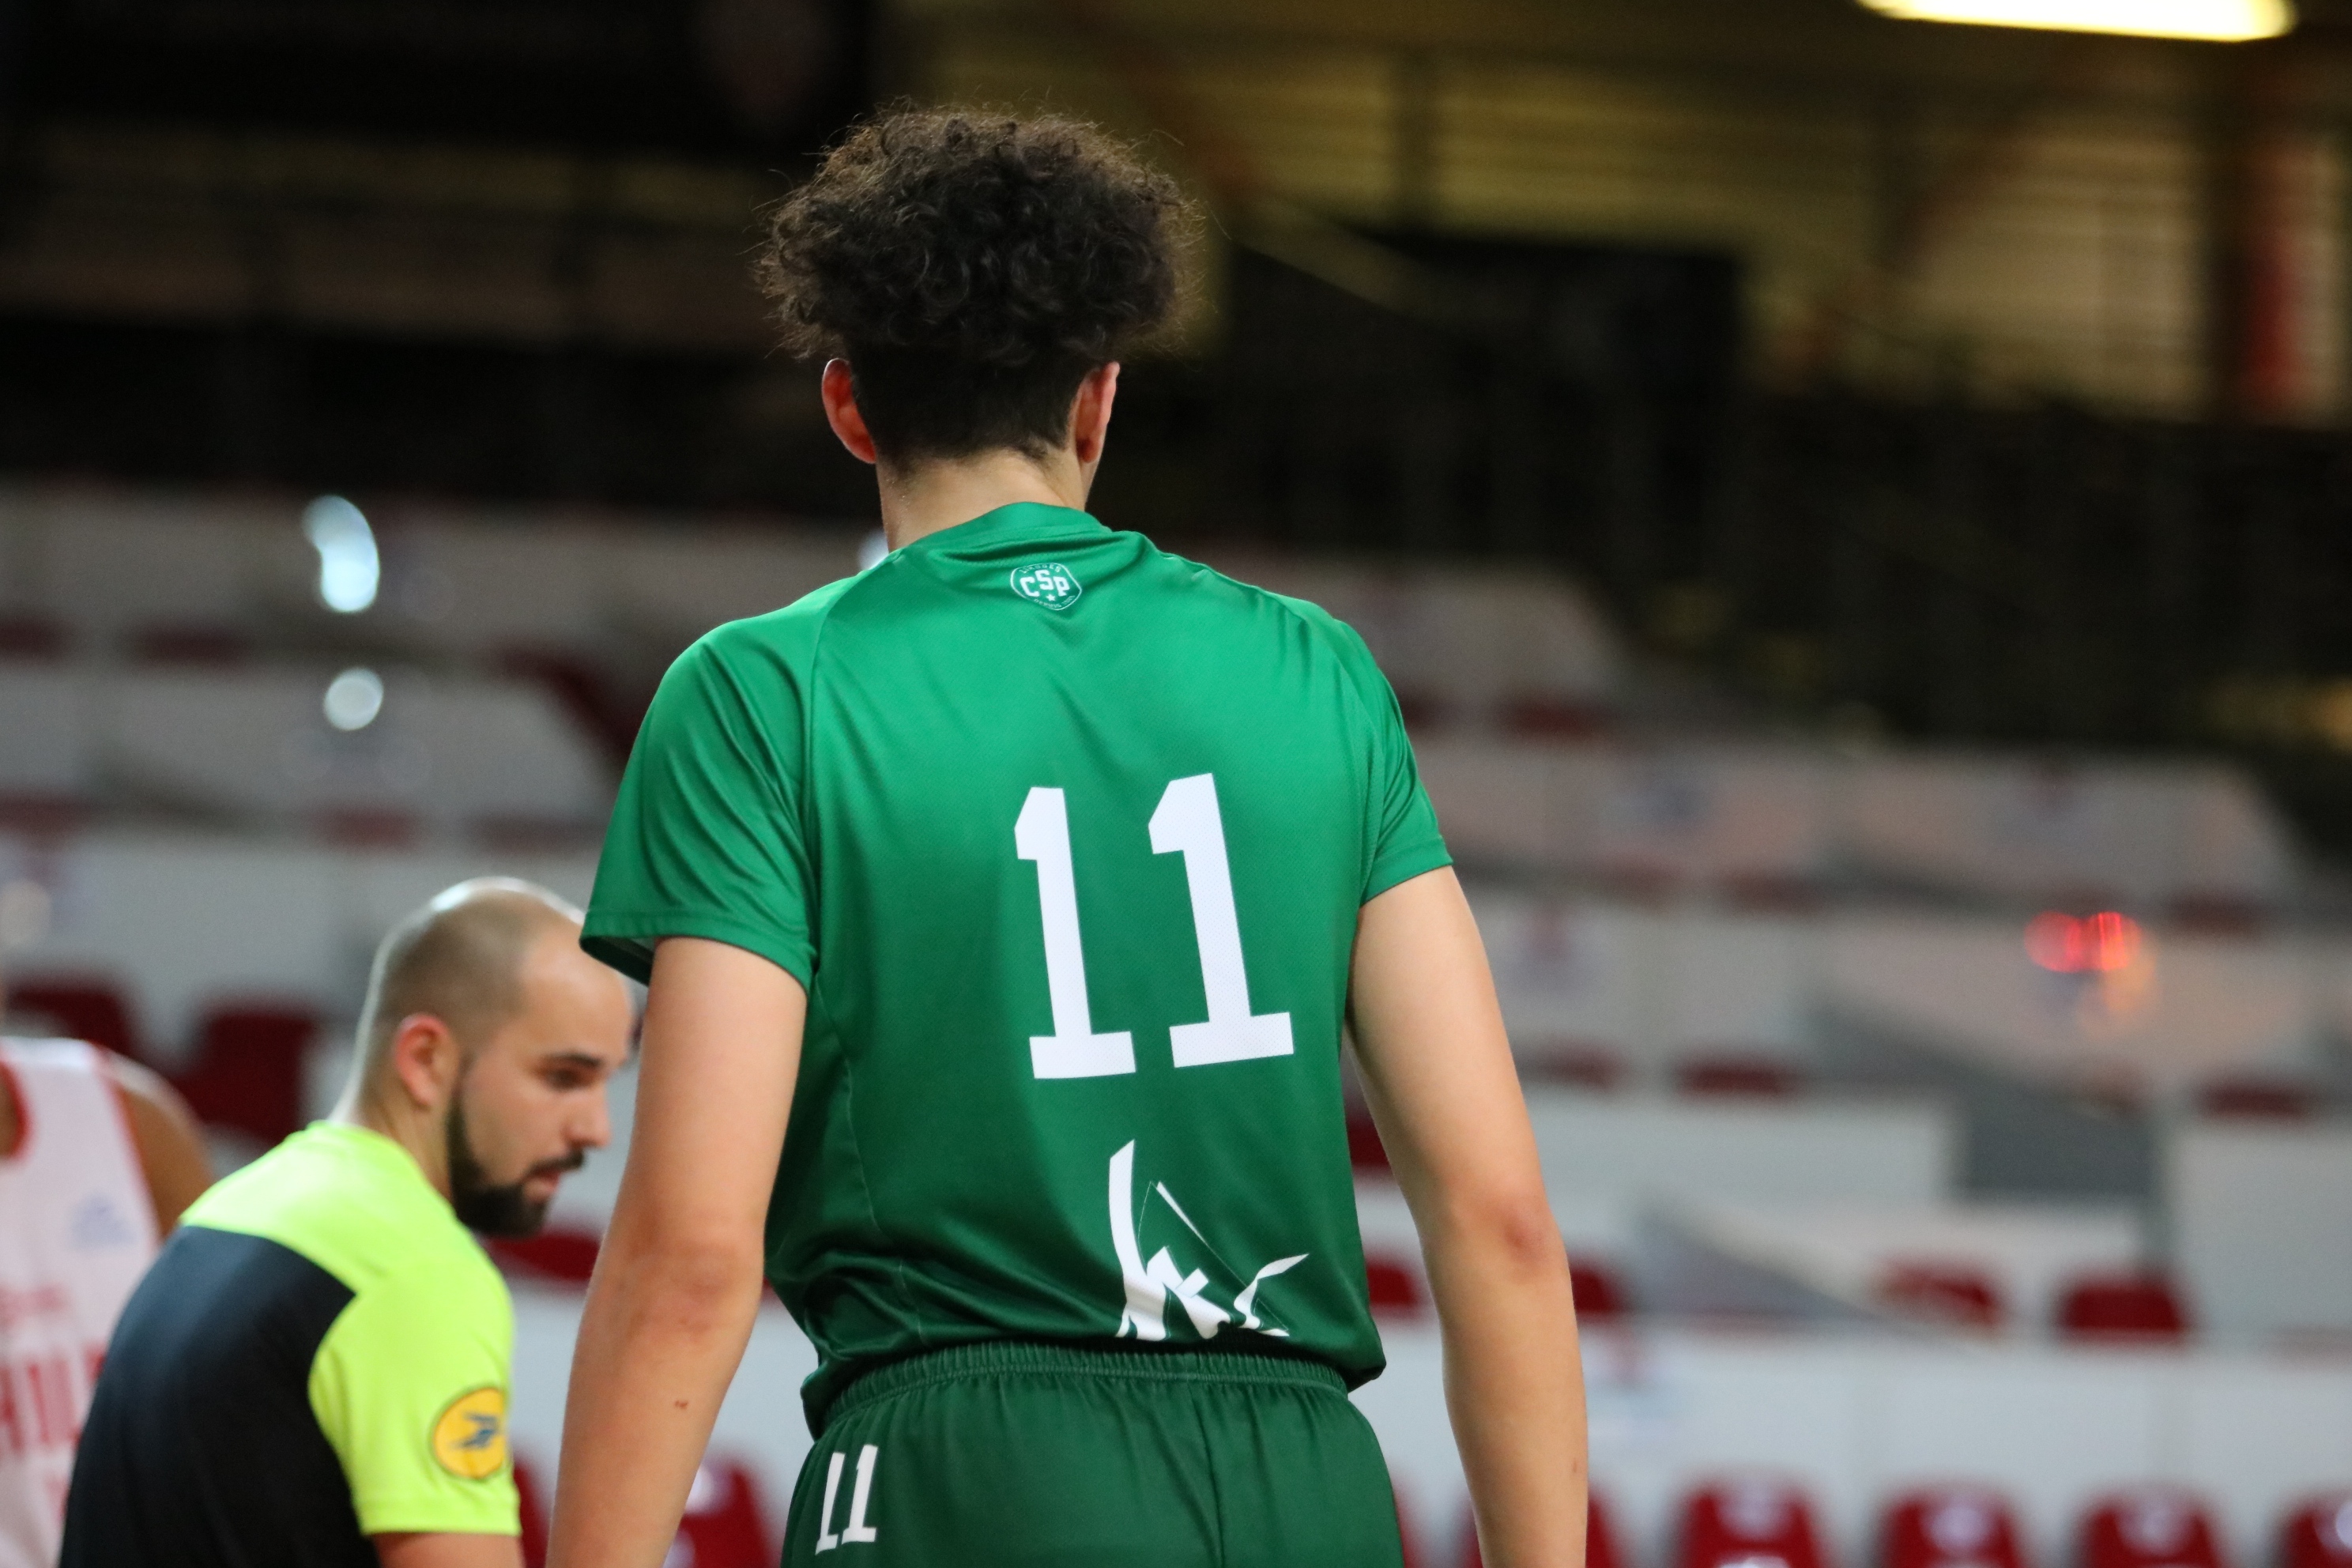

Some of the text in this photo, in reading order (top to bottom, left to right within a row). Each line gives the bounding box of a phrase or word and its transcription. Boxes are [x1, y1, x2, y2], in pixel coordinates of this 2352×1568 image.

[1020, 570, 1070, 597] CSP
[1015, 773, 1295, 1079] 11
[815, 1444, 879, 1555] 11
